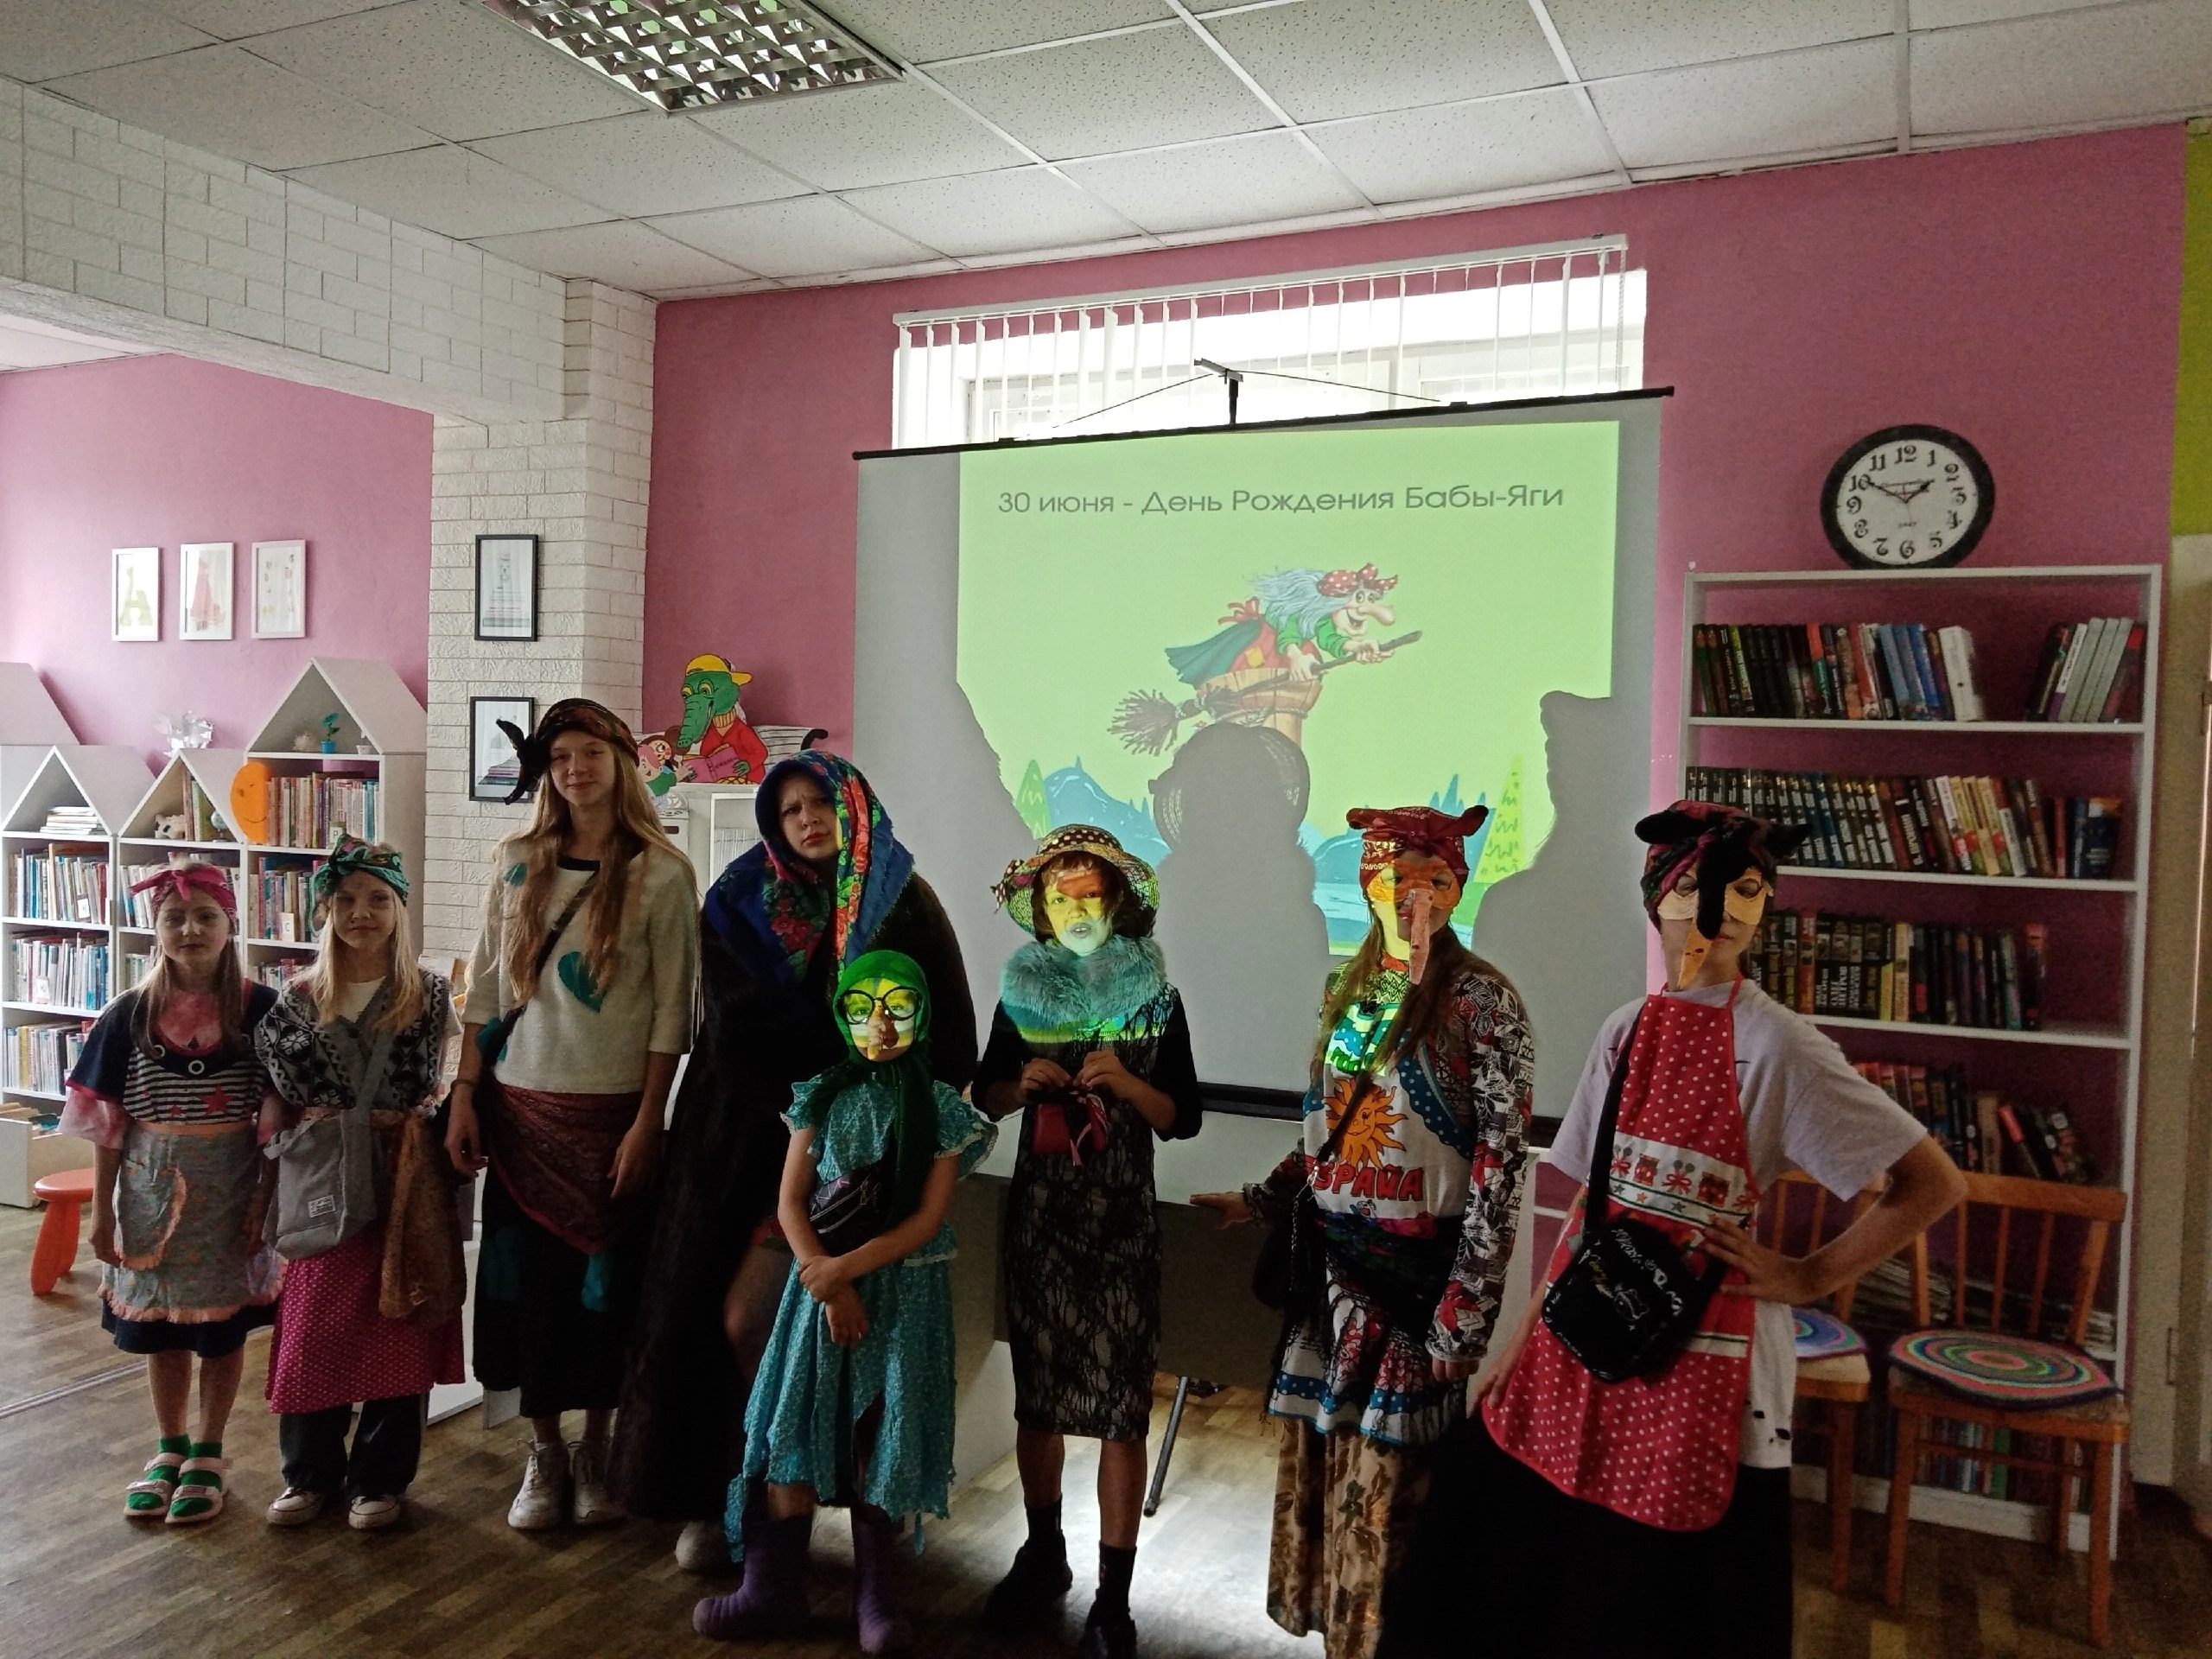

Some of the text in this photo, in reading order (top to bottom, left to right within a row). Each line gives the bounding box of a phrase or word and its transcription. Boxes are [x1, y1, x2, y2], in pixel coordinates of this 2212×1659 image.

[1869, 454, 1886, 472] 11
[1894, 445, 1916, 464] 12
[1945, 463, 1959, 482] 2
[999, 492, 1031, 512] 30
[1039, 496, 1115, 512] июня
[1141, 492, 1223, 515] День
[1232, 489, 1394, 513] Рождения
[1406, 485, 1563, 508] Бабы-Яги
[1847, 496, 1862, 514] 9
[1951, 486, 1967, 505] 3
[1854, 519, 1868, 538] 8
[1900, 540, 1915, 559] 6
